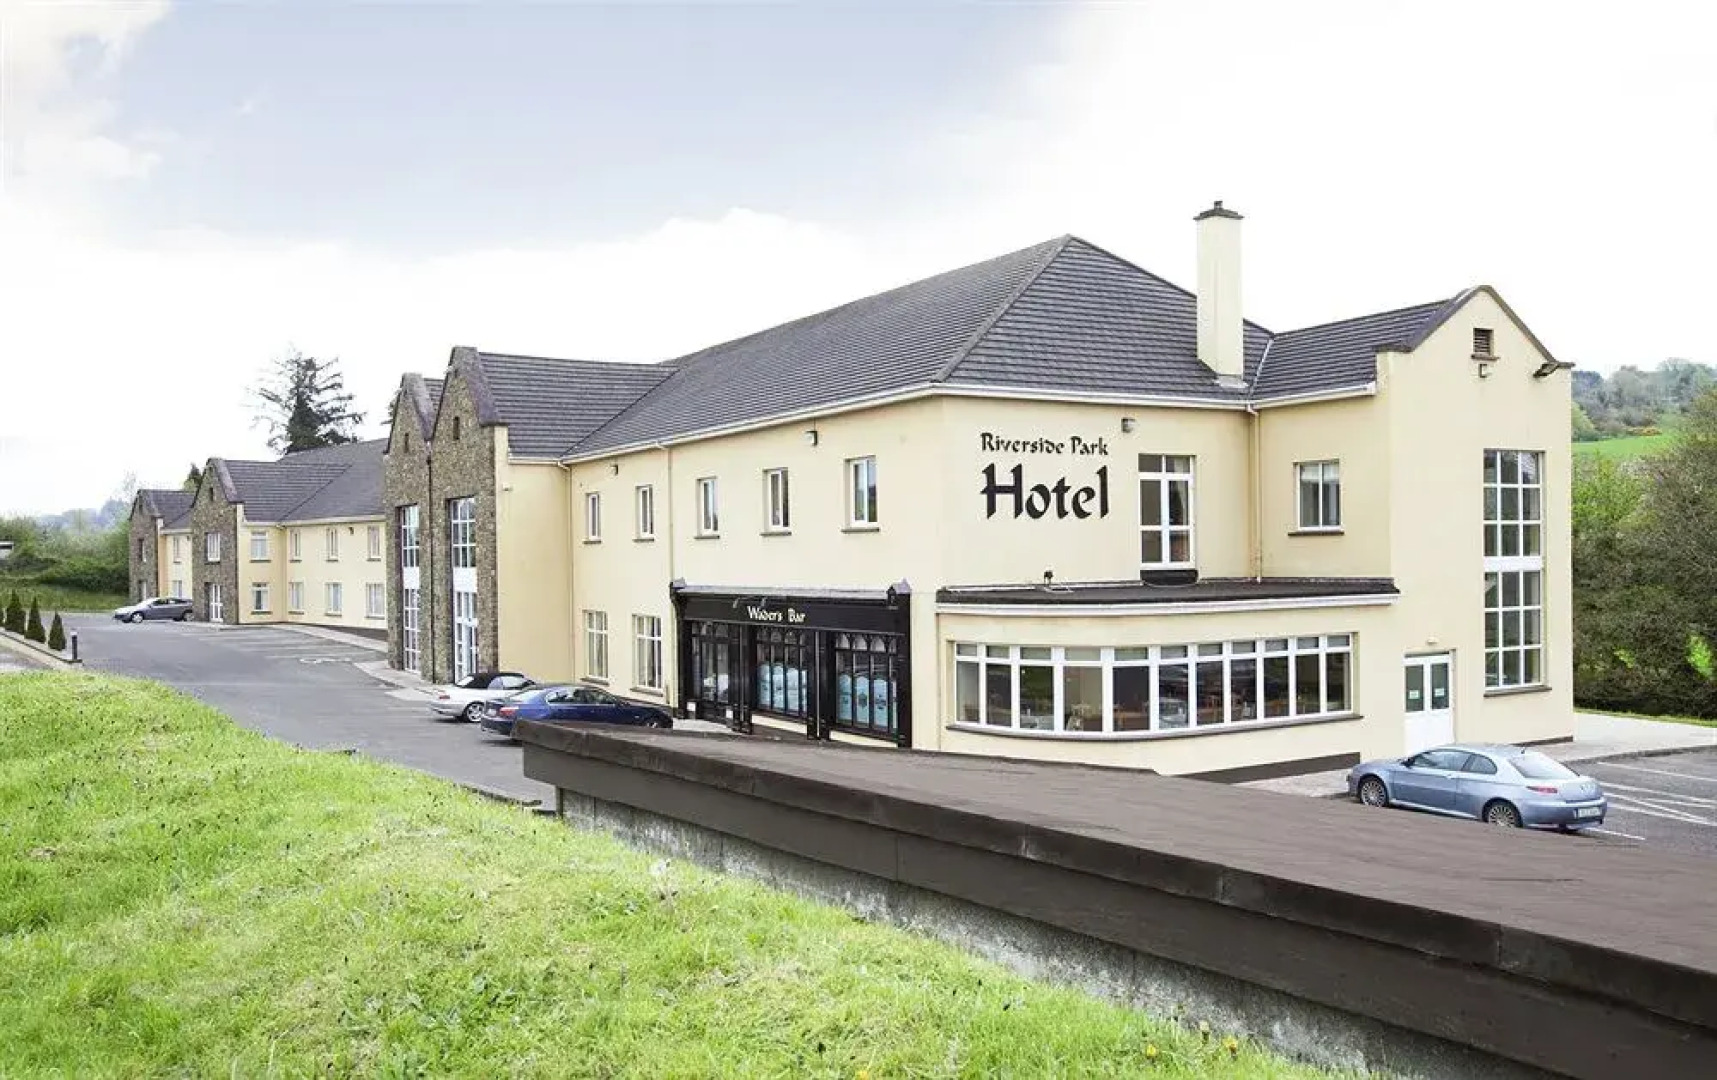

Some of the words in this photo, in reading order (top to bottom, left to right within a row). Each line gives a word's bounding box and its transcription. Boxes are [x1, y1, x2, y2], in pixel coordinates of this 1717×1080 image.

[980, 432, 1065, 454] Riverside
[1070, 435, 1109, 456] Park
[980, 463, 1109, 519] Hotel
[788, 607, 806, 623] Bar
